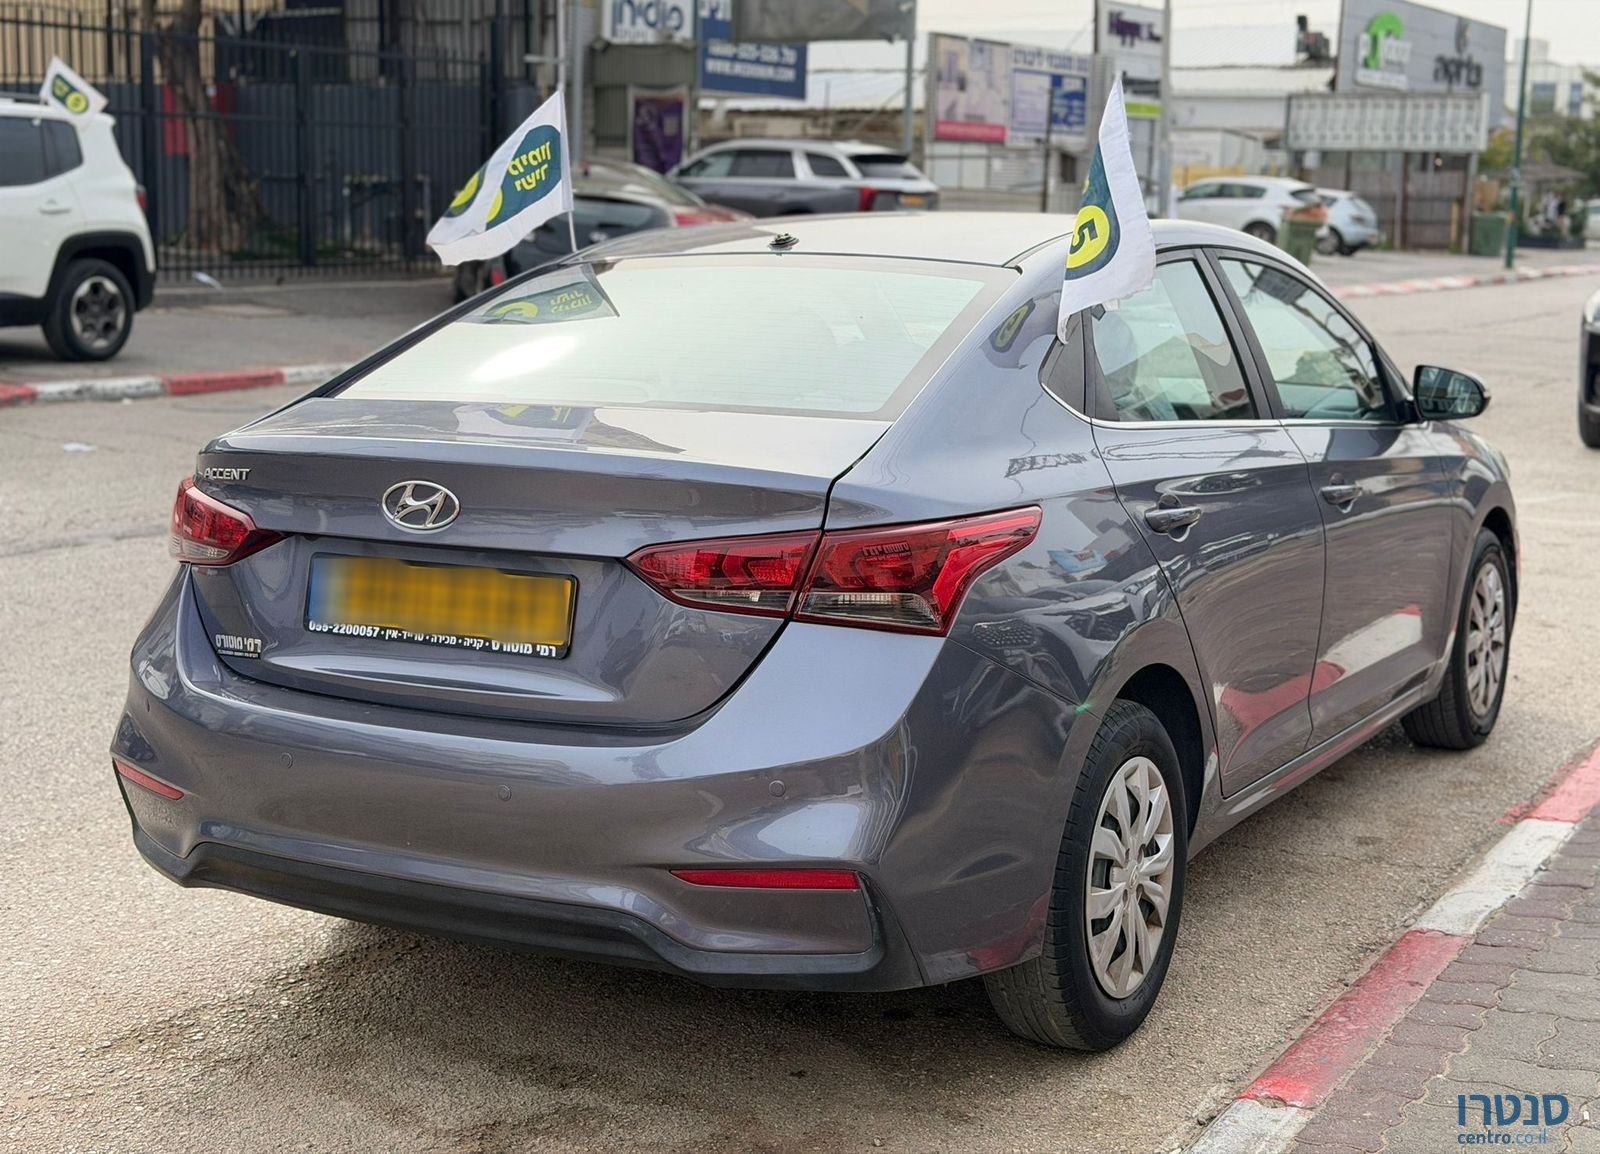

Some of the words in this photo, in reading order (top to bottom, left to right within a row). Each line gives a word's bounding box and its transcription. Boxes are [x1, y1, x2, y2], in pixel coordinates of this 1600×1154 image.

[203, 467, 251, 481] ACCENT
[308, 620, 380, 637] 055-2200057
[215, 634, 243, 650] מוטורס
[244, 637, 262, 653] רמי
[430, 634, 457, 645] מכירה
[463, 637, 484, 650] קניה
[536, 644, 557, 657] רמי
